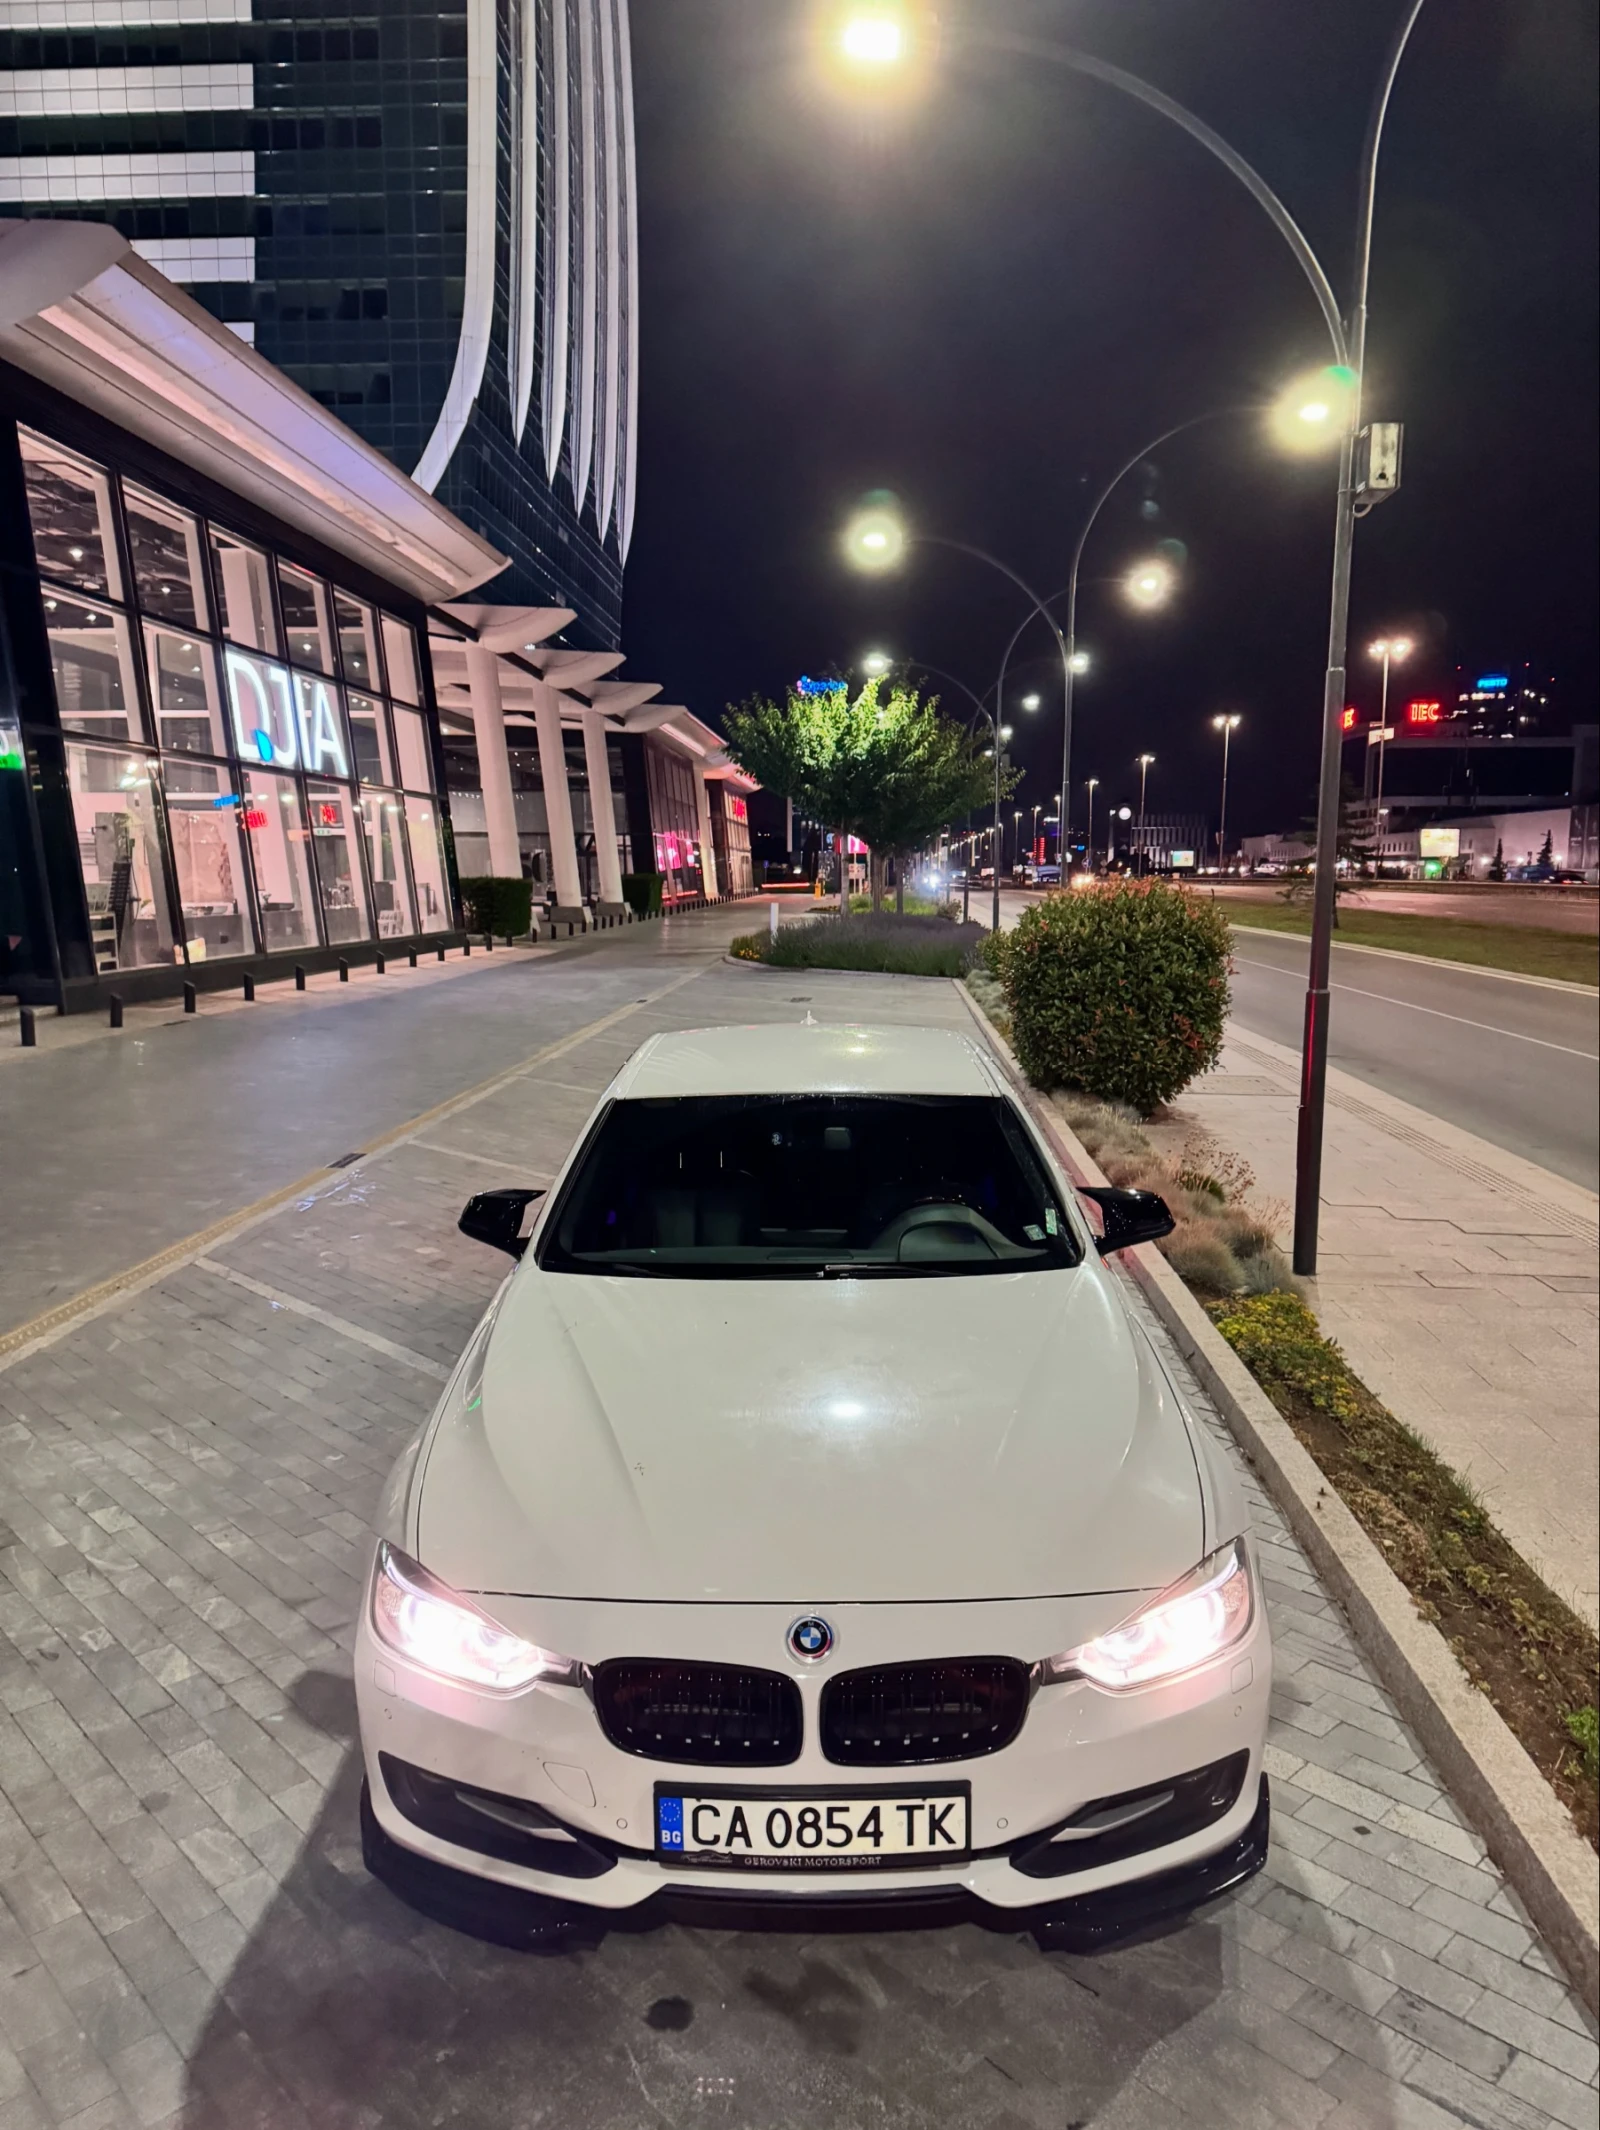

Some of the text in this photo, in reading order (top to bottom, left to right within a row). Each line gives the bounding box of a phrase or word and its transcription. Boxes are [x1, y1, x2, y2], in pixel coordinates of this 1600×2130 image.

[1411, 703, 1440, 721] IEC
[692, 1803, 956, 1849] CA 0854 TK
[661, 1830, 682, 1844] BG
[744, 1856, 801, 1867] GEROVSKI
[804, 1856, 882, 1867] MOTORSPORT
